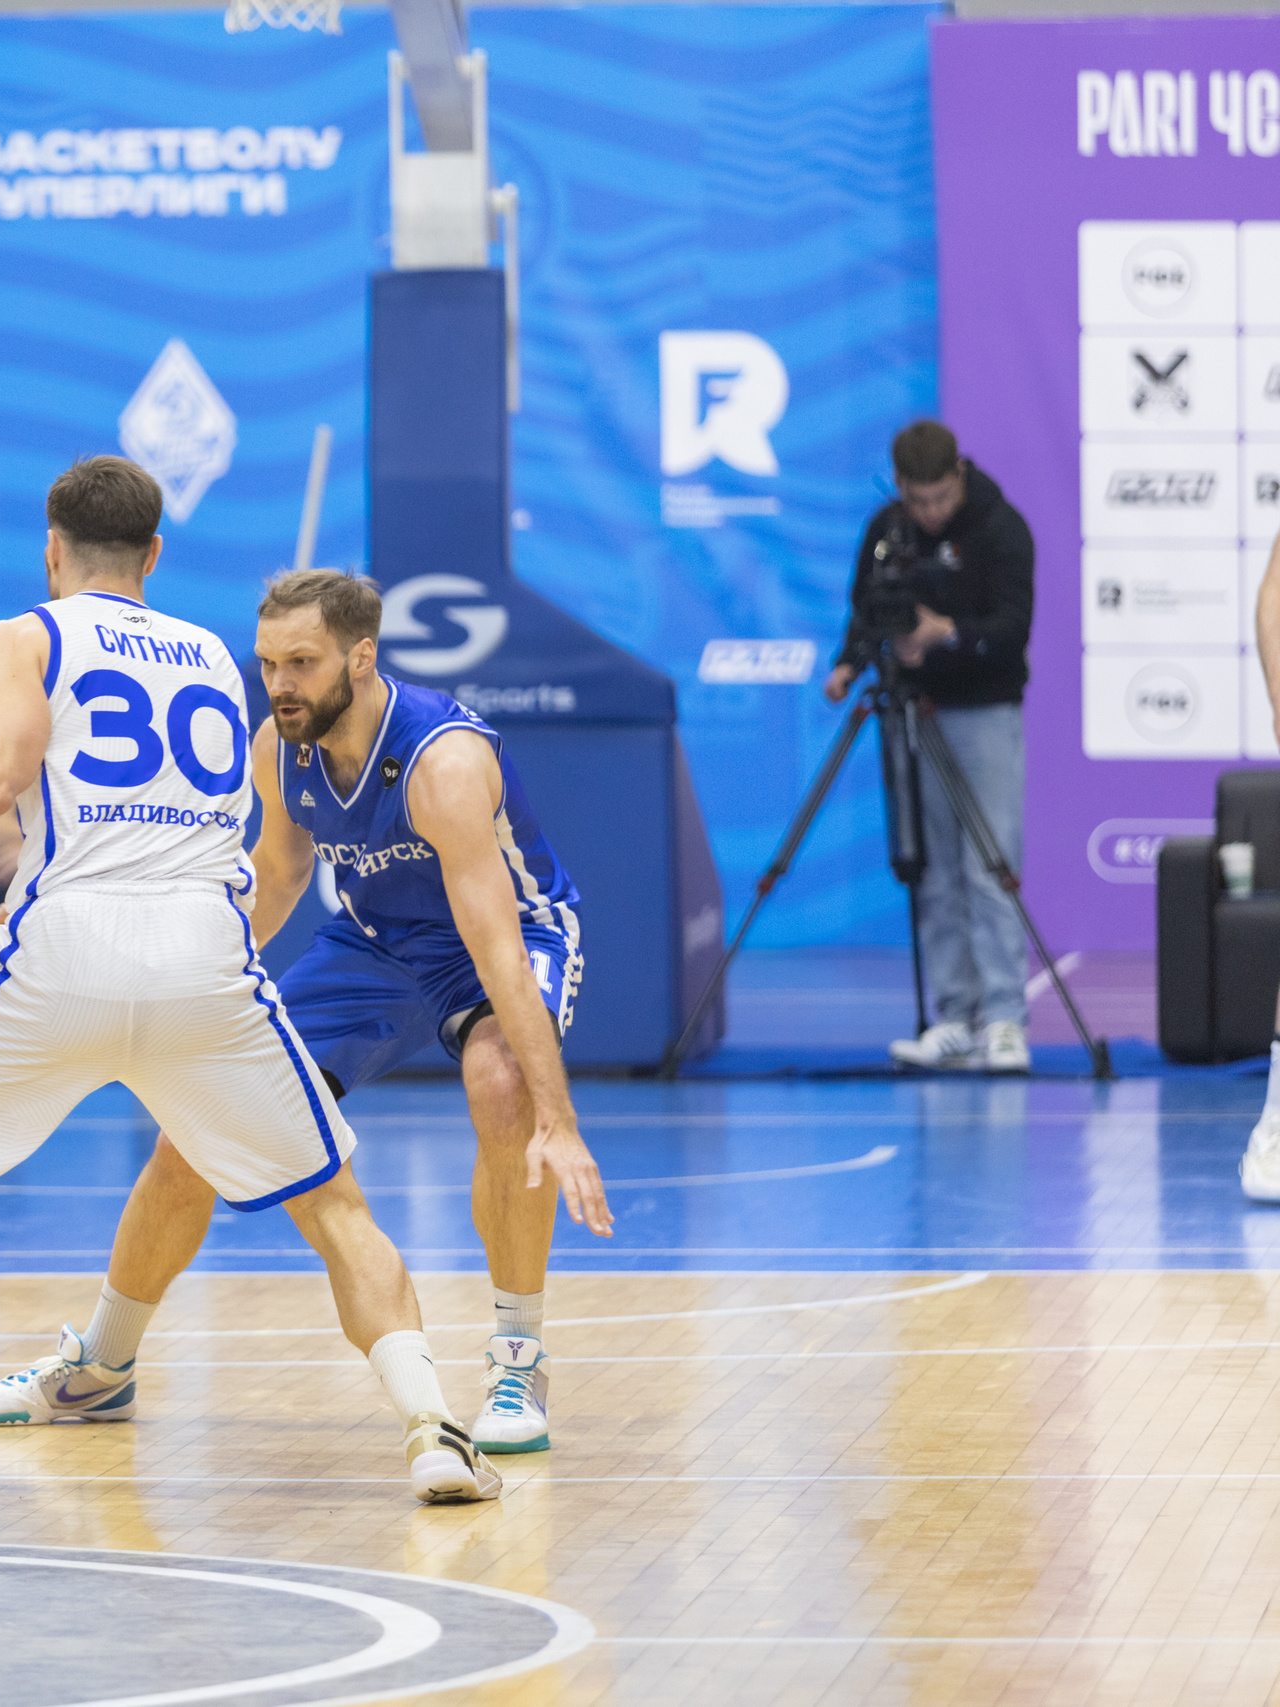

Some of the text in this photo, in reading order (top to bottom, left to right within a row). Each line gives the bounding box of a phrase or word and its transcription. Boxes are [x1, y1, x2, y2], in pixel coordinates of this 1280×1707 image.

[1077, 69, 1199, 158] PARI
[94, 623, 211, 671] СИТНИК
[68, 668, 248, 798] 30
